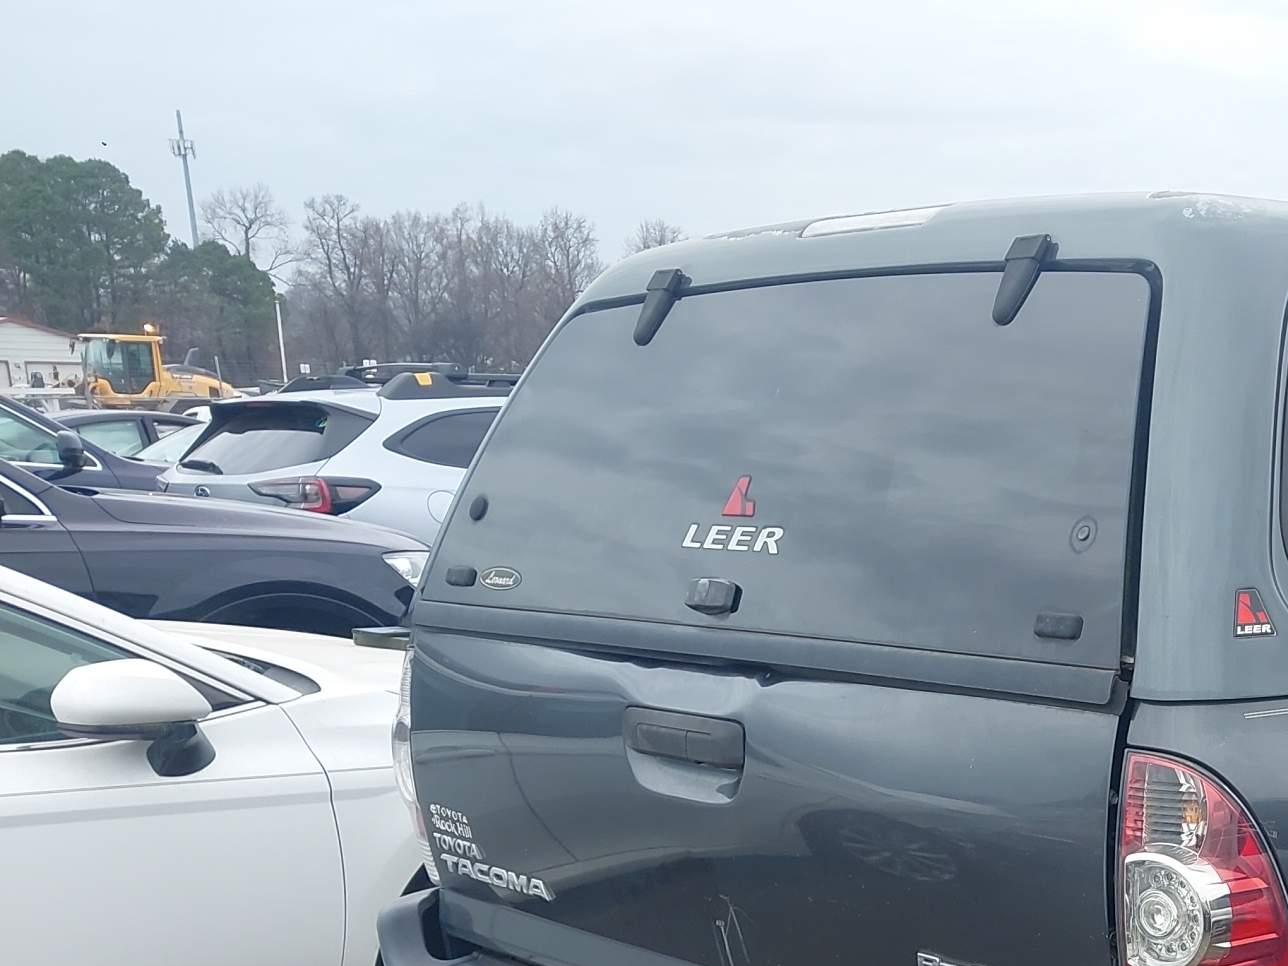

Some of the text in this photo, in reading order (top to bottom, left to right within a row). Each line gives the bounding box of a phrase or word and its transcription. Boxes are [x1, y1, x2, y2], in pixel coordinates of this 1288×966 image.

[682, 523, 785, 554] LEER
[1237, 624, 1271, 635] LEER
[435, 815, 459, 836] Rock
[436, 805, 468, 823] TOYOTA
[433, 832, 482, 859] TOYOTA
[441, 853, 553, 902] TACOMA
